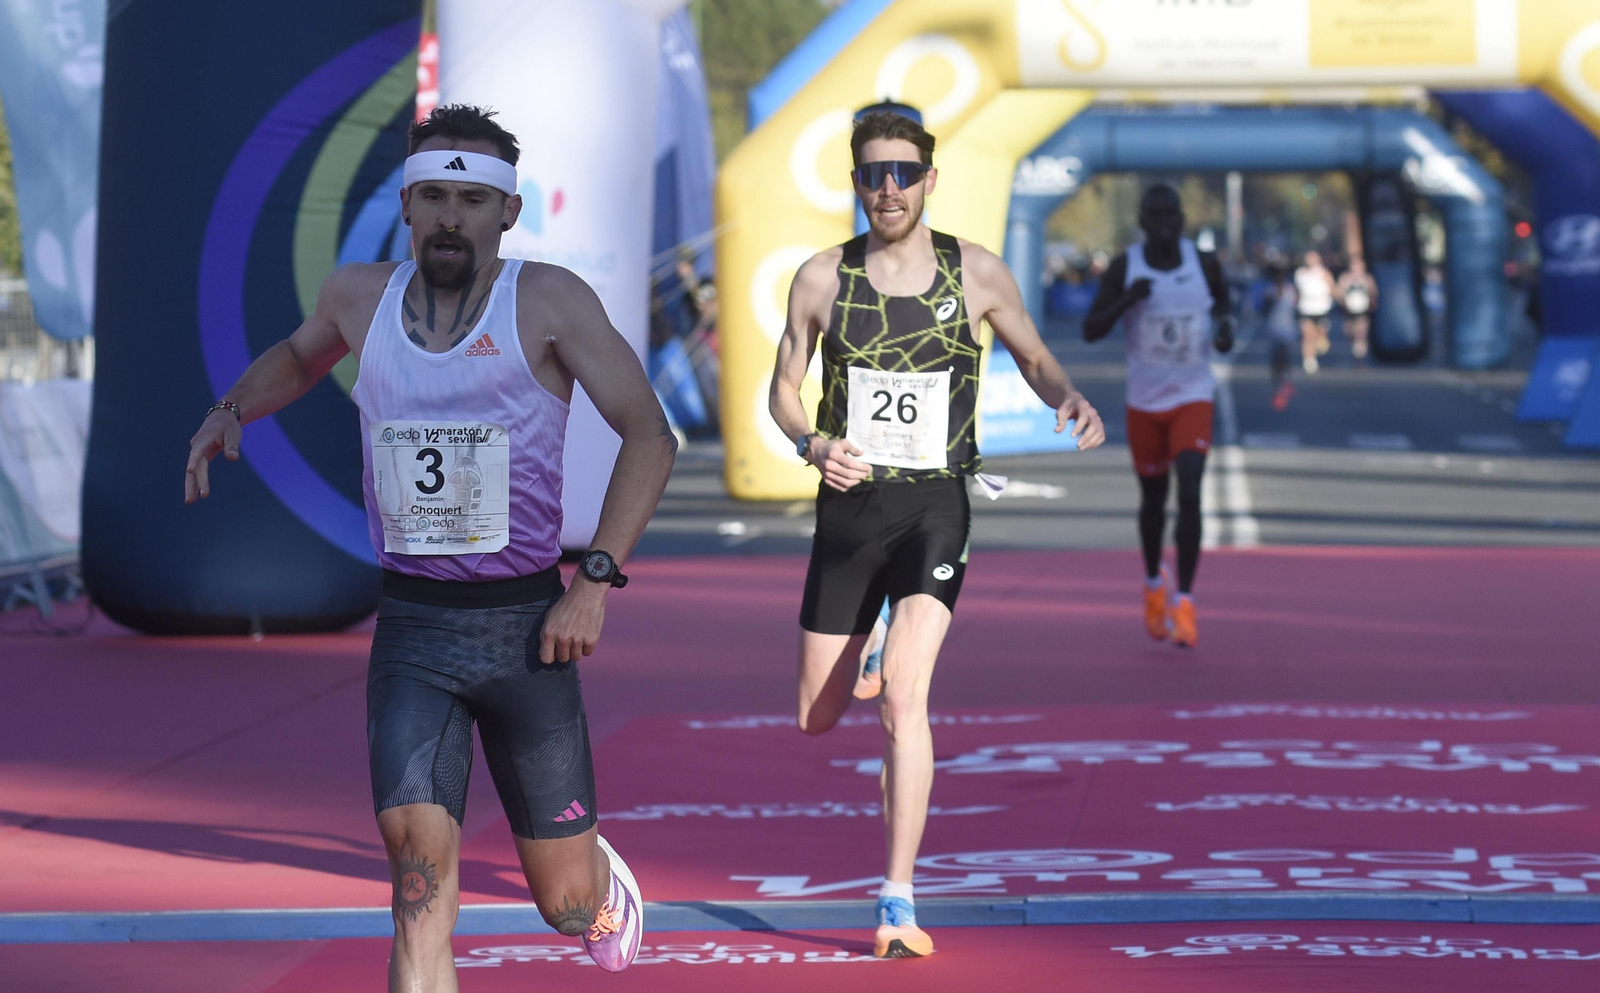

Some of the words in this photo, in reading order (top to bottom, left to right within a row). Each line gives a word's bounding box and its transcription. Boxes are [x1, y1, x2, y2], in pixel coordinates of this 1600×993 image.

[465, 348, 501, 357] adidas
[870, 389, 918, 425] 26
[396, 427, 421, 443] edp
[437, 427, 483, 436] maratón
[448, 434, 482, 444] sevilla
[415, 448, 445, 495] 3
[411, 505, 462, 517] Choquert
[432, 516, 455, 530] edp
